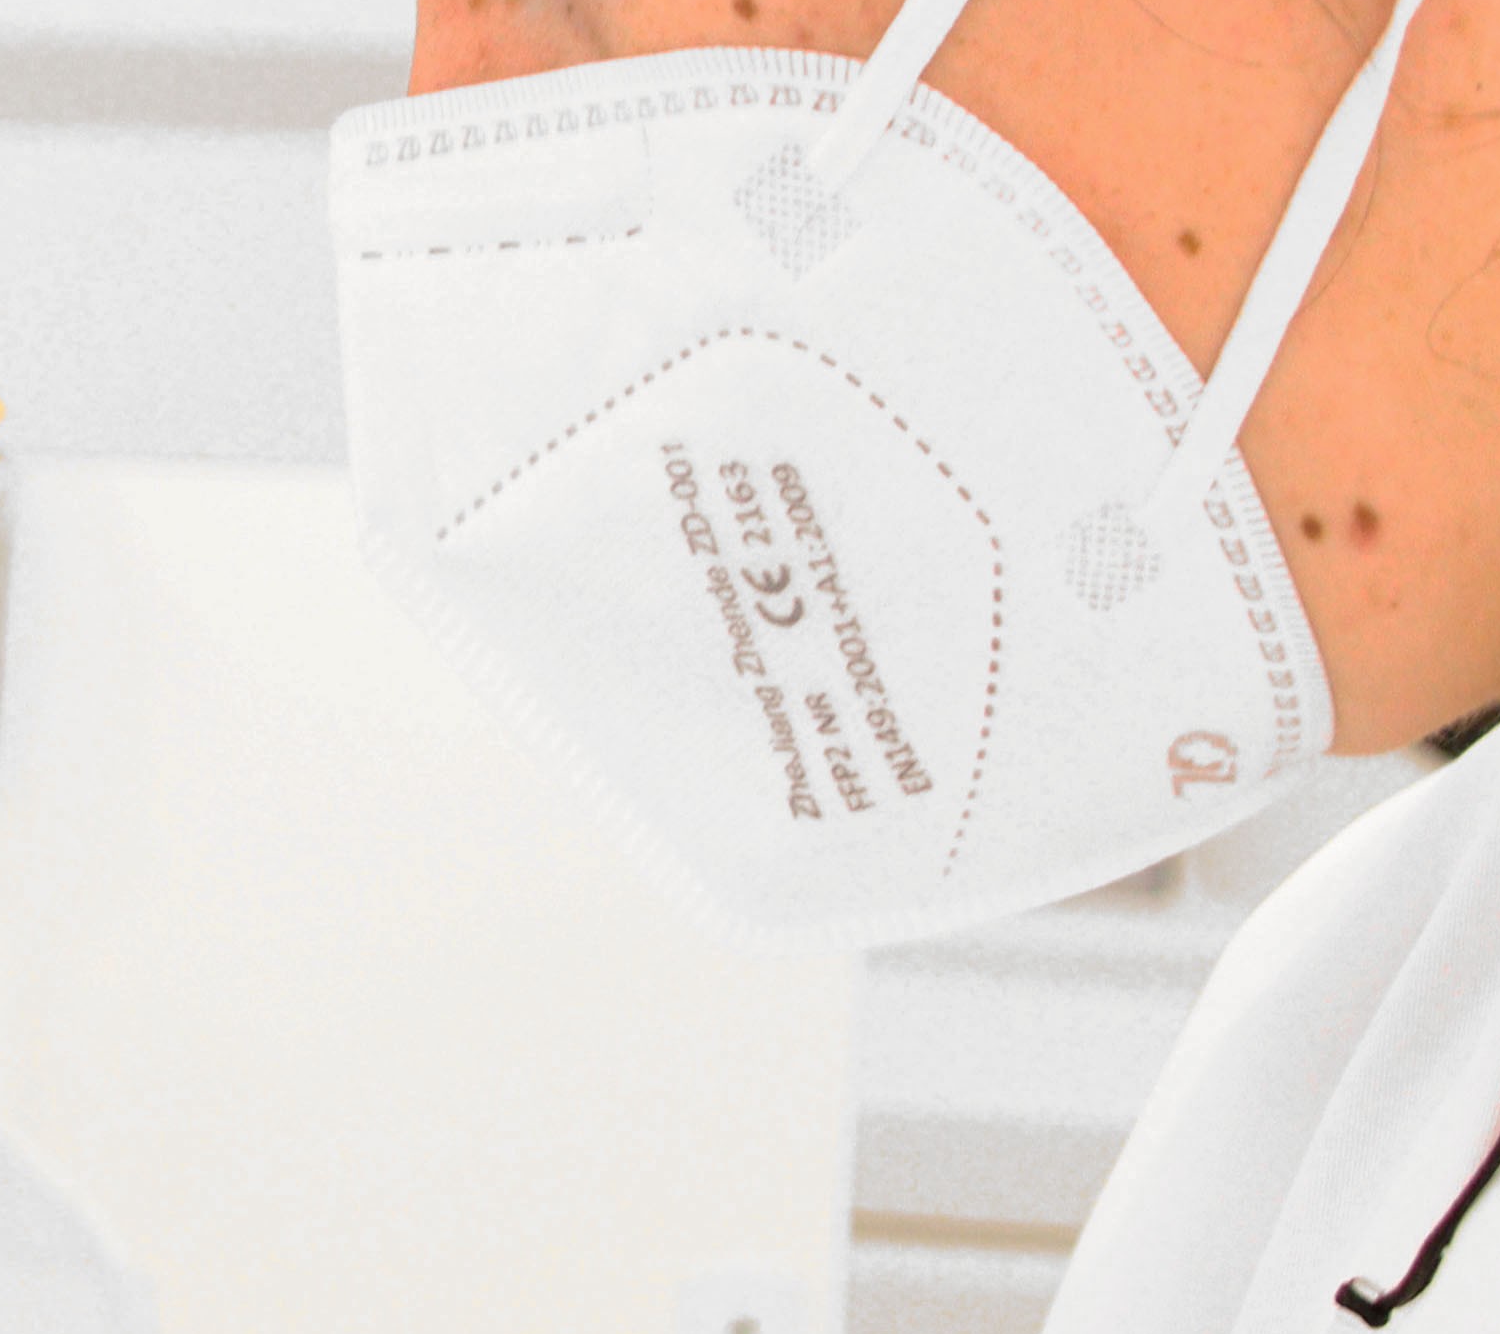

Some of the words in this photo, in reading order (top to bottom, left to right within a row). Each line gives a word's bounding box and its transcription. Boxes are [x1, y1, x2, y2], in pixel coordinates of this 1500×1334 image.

[660, 443, 720, 556] ZD-001
[718, 460, 774, 547] 2163
[706, 564, 767, 677] Zhende
[770, 461, 934, 797] EN149:2001+A1:2009
[754, 685, 823, 820] ZheJiang
[804, 692, 841, 736] NR
[823, 745, 876, 813] FFP2
